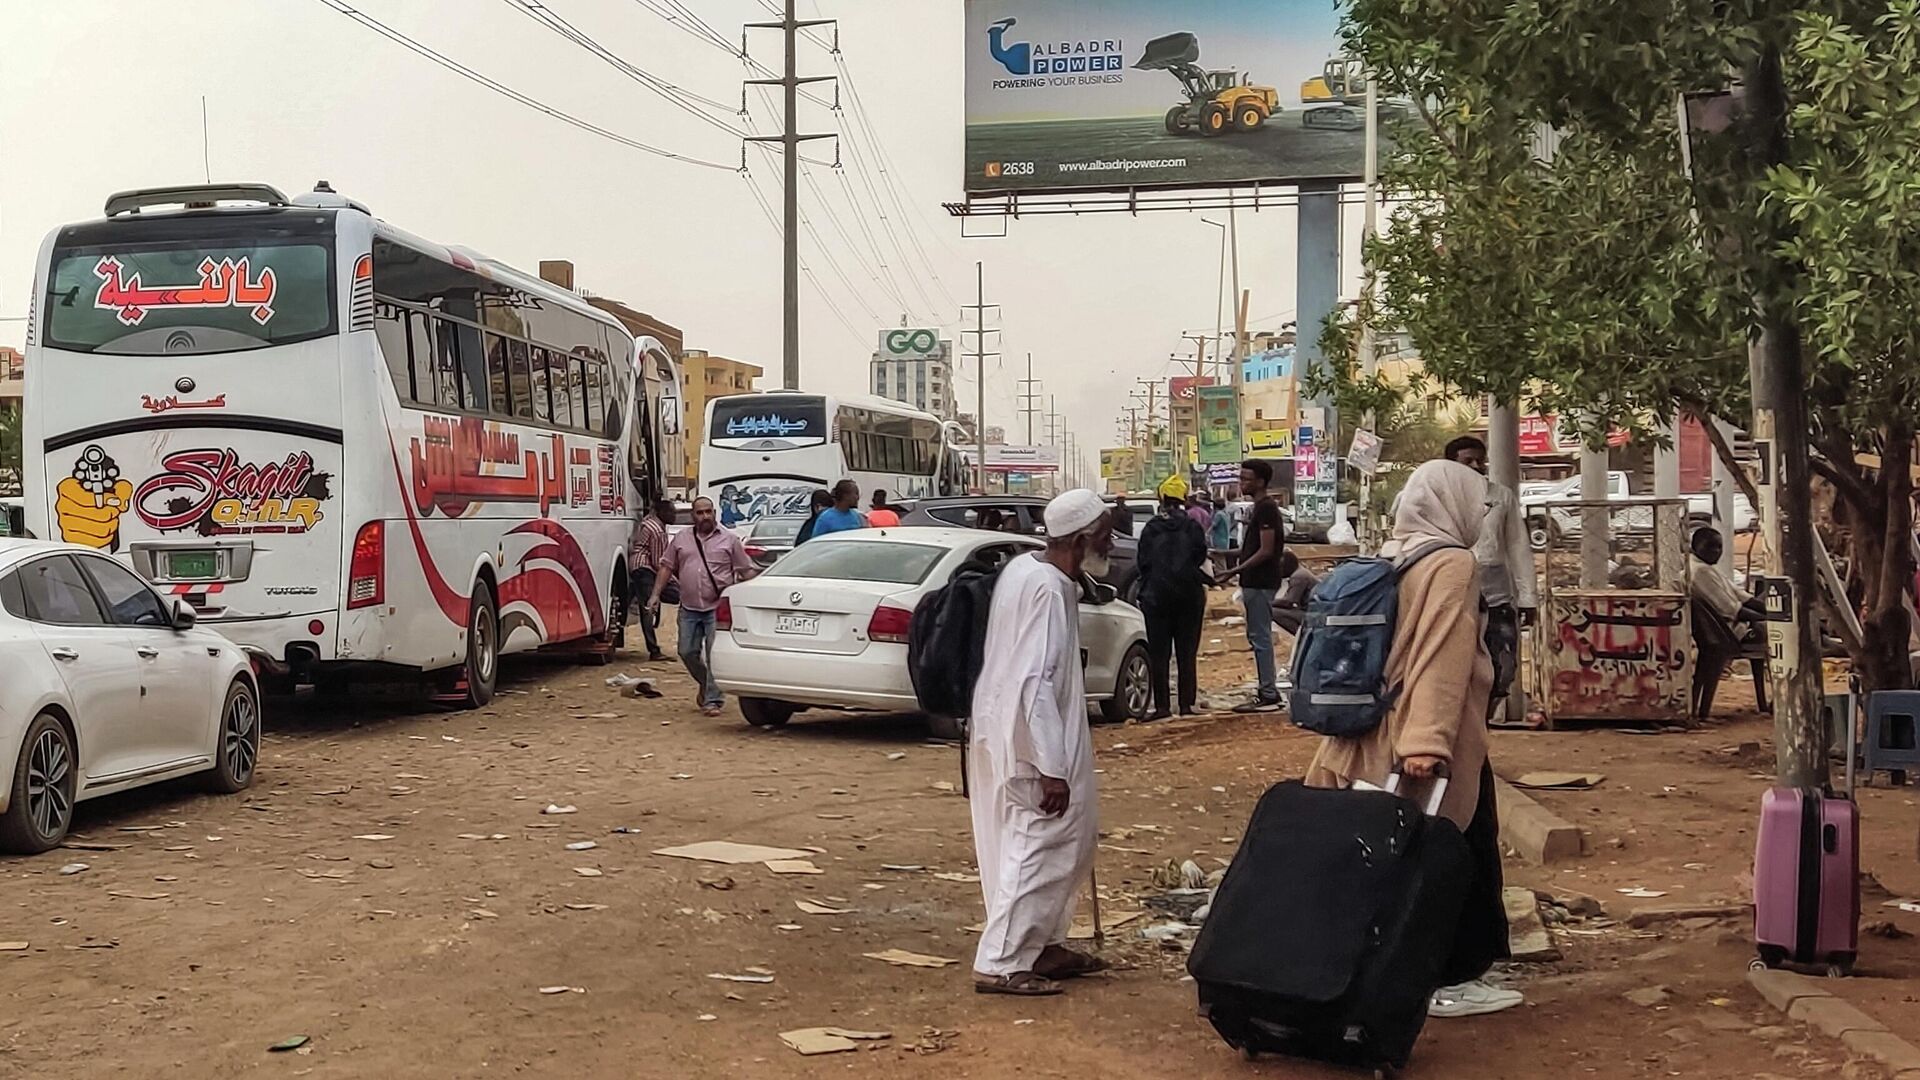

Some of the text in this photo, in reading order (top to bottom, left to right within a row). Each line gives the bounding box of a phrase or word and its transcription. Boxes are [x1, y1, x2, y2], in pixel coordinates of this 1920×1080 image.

[1033, 39, 1122, 55] ALBADRI
[1035, 56, 1121, 73] POWER
[993, 74, 1123, 89] POWERING YOUR BUSINESS
[1002, 161, 1035, 175] 2638
[1058, 157, 1187, 172] www.albadripower.com
[93, 254, 277, 326] بالنية
[886, 329, 936, 354] GO
[134, 448, 314, 530] Skagit
